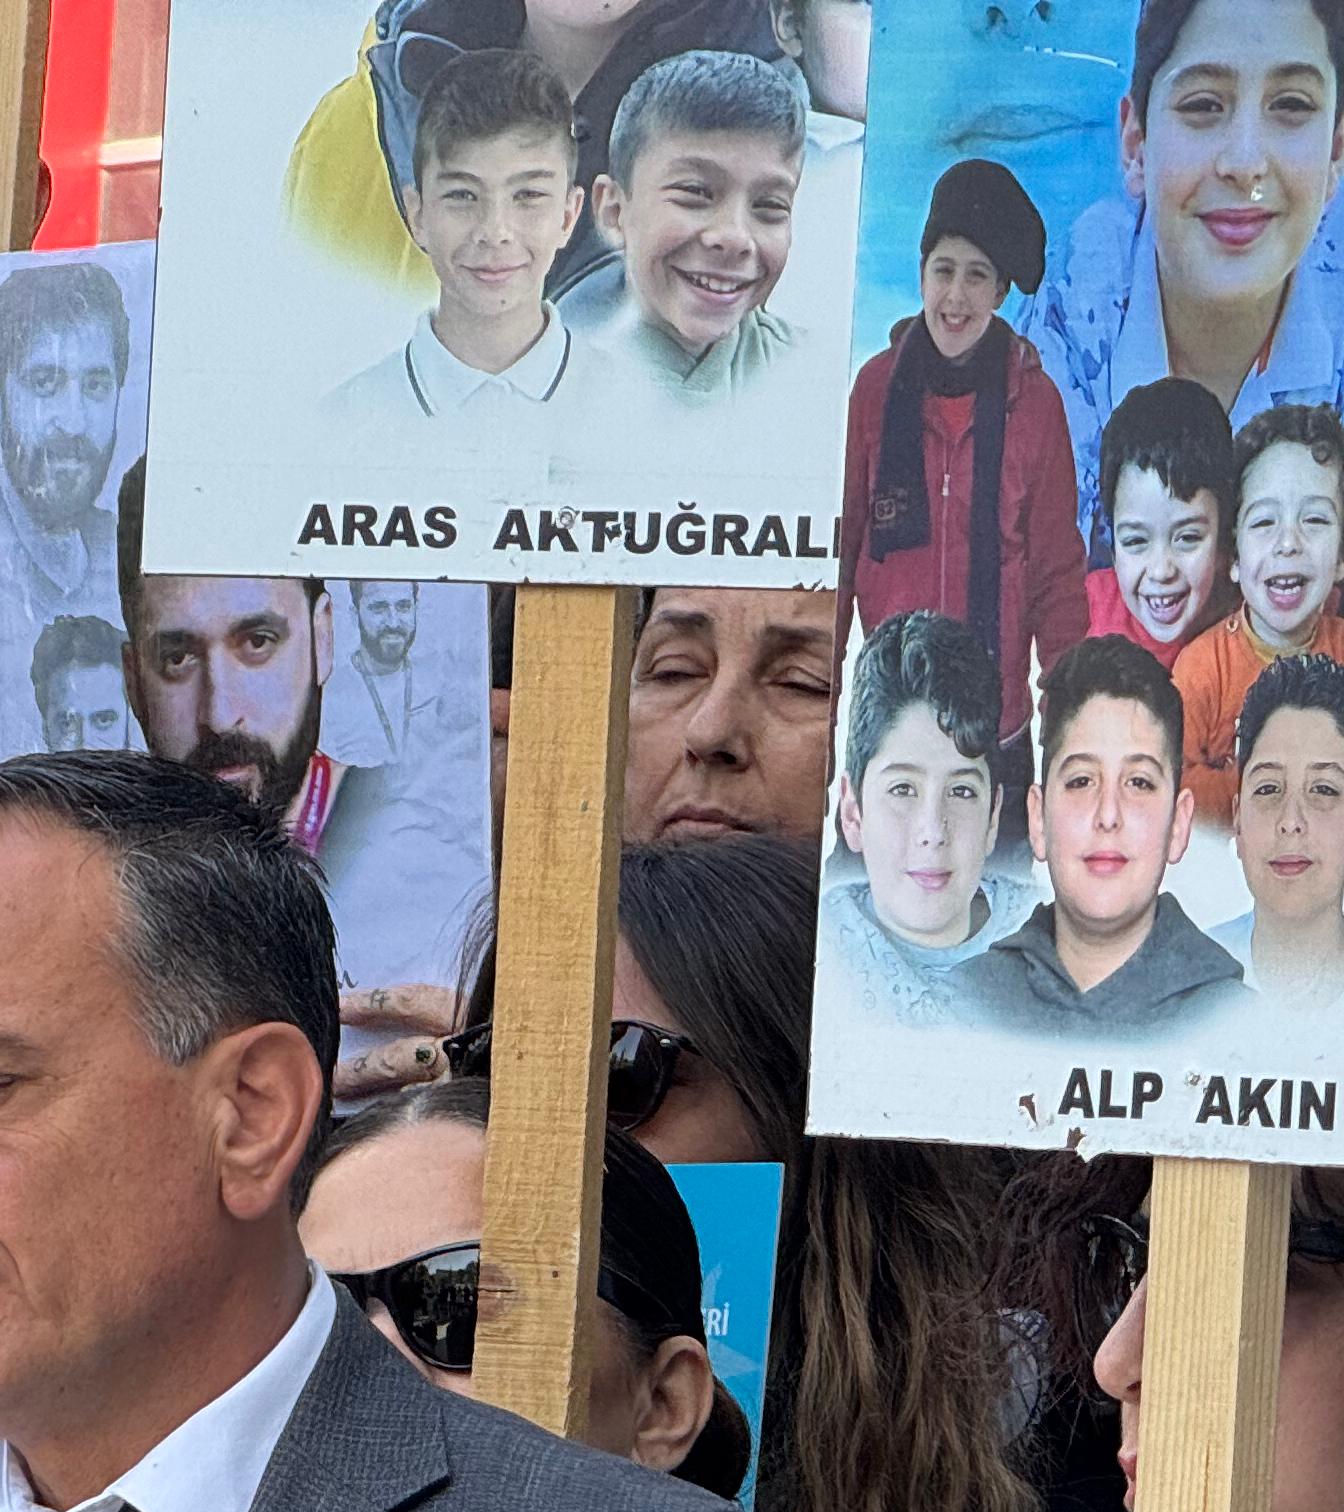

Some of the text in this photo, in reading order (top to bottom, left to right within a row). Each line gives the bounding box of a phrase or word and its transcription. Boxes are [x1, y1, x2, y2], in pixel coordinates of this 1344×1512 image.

[297, 503, 458, 550] ARAS
[1058, 1067, 1337, 1131] ALP AKIN
[701, 1301, 730, 1336] Rİ
